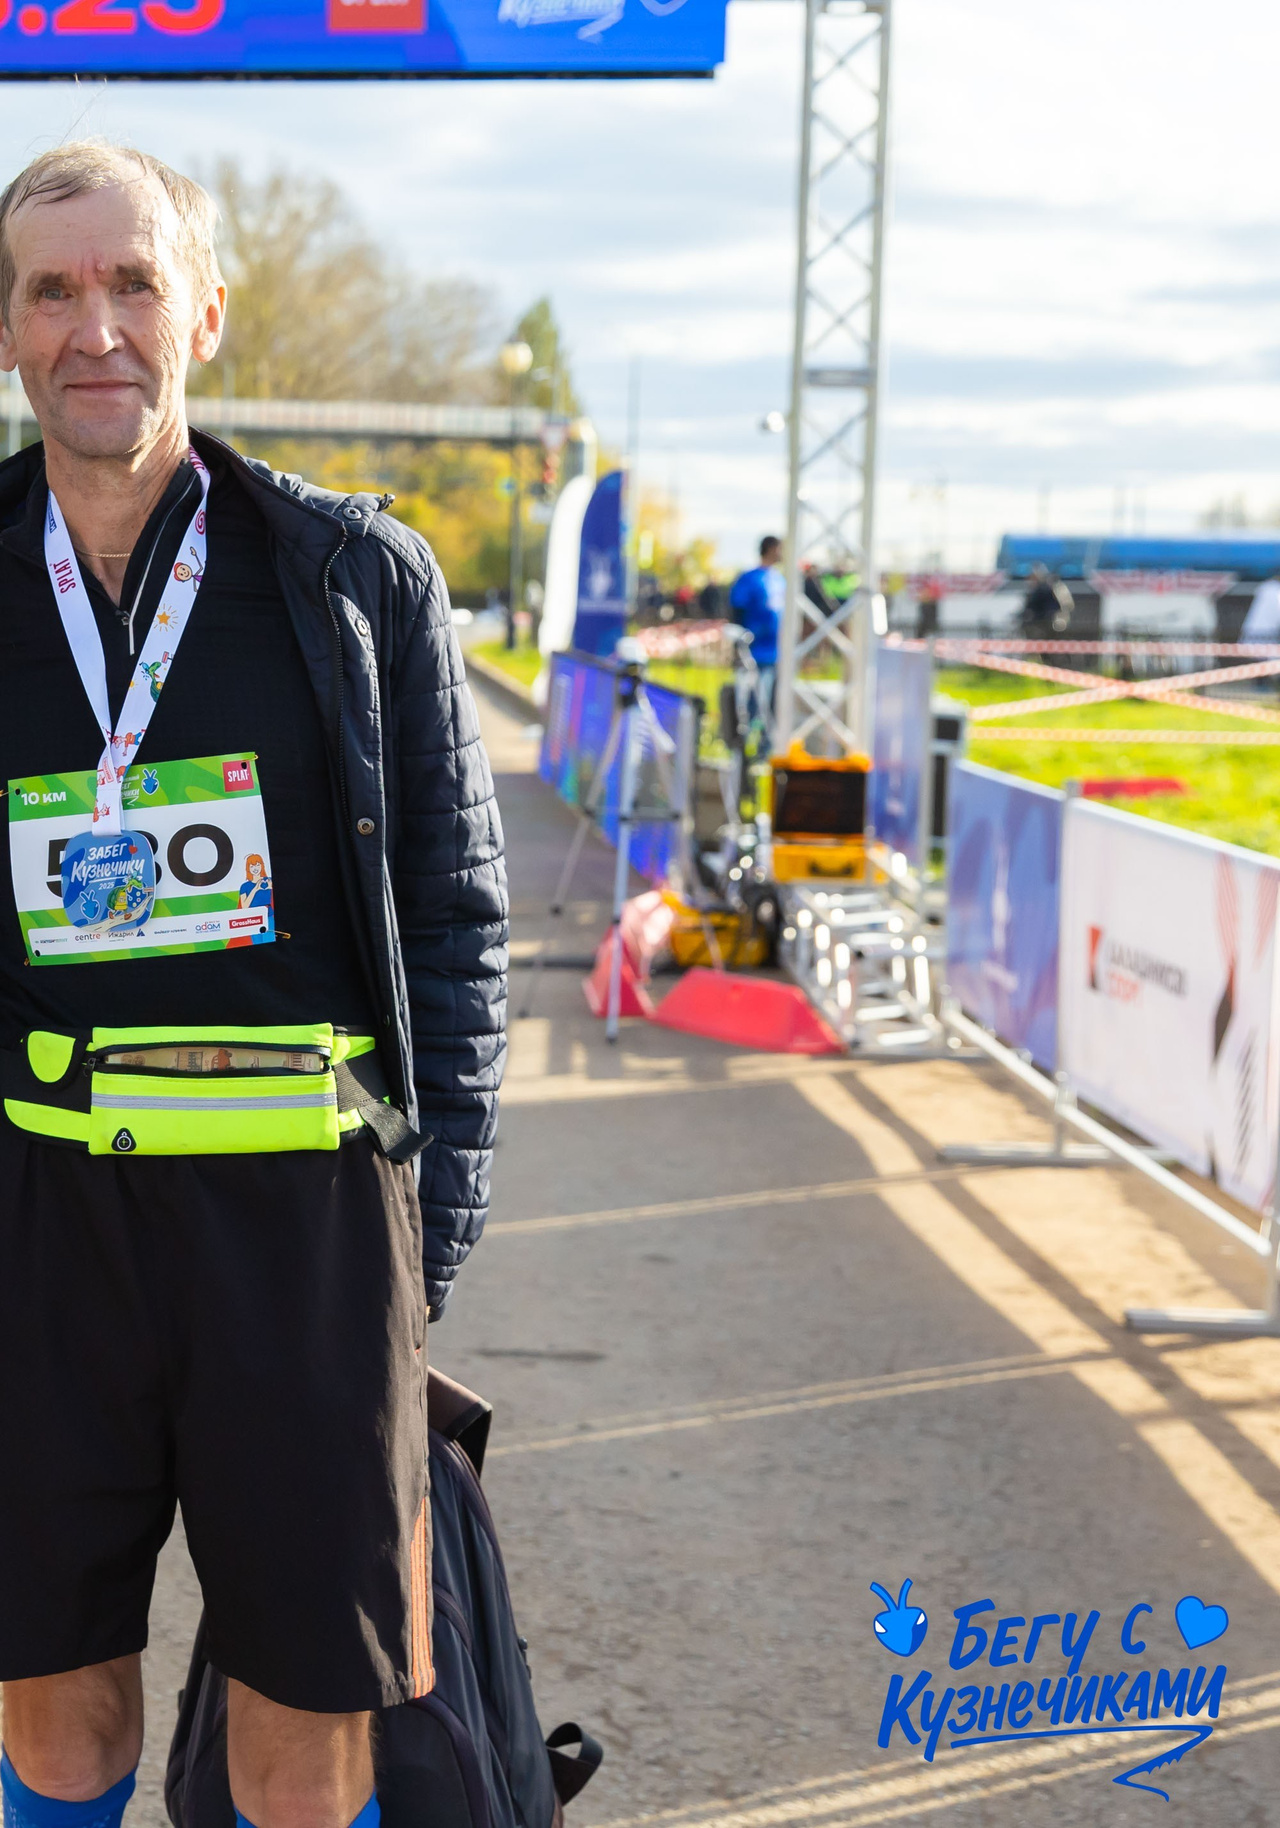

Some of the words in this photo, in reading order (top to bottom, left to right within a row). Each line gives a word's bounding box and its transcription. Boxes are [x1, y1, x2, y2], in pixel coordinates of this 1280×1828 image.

[53, 558, 76, 594] SPLAT
[228, 771, 248, 783] SPLAT
[21, 793, 41, 806] 10
[87, 843, 127, 861] ЗАБЕГ
[71, 859, 145, 886] Кузнечики
[98, 881, 115, 890] 2025
[231, 918, 261, 928] GrossHaus
[74, 932, 101, 942] centre
